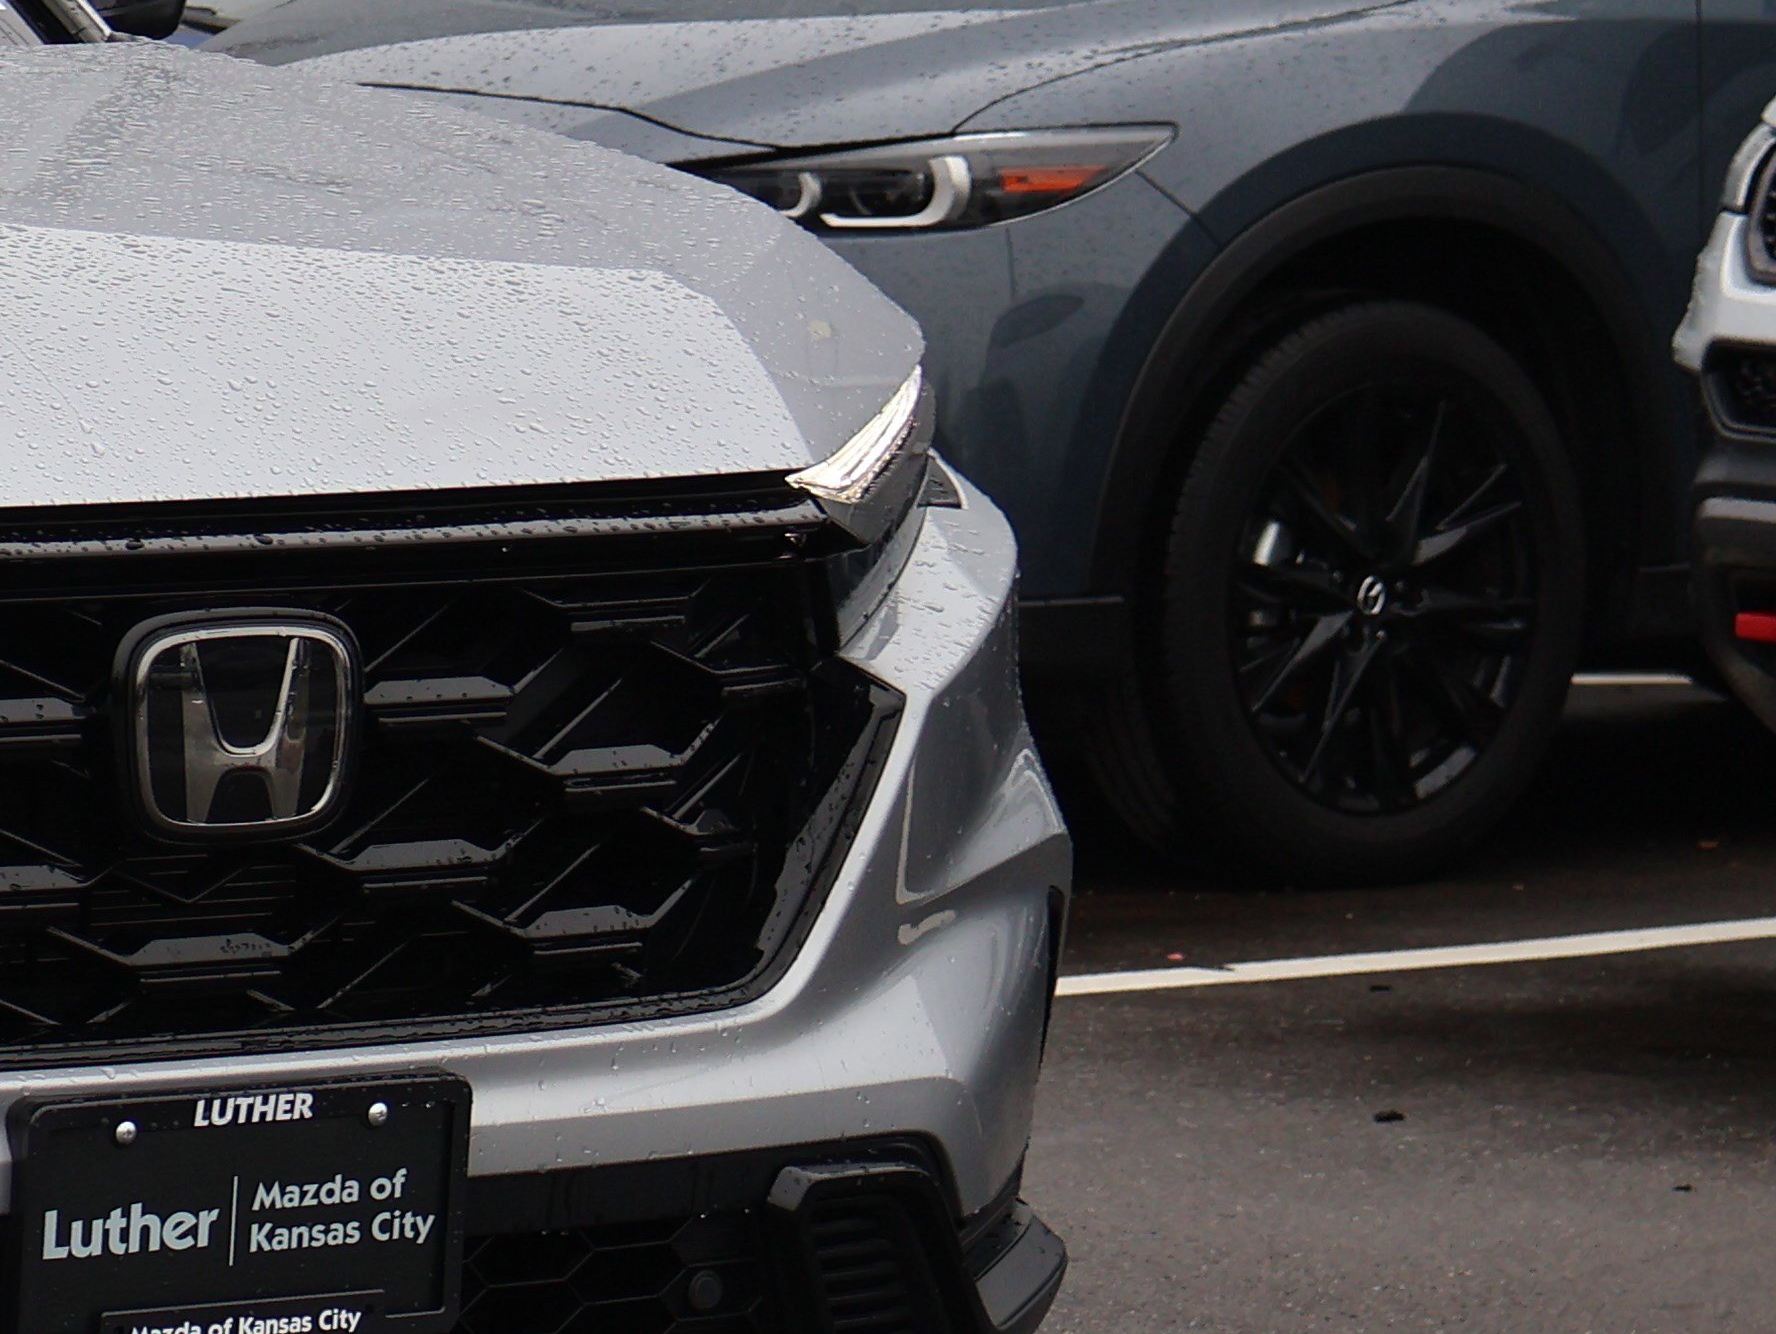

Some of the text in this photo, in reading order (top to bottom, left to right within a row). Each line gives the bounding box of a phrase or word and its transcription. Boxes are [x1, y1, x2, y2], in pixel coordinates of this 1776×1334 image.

[193, 1092, 314, 1127] LUTHER
[251, 1167, 409, 1211] Mazda of
[42, 1201, 221, 1260] Luther
[249, 1210, 436, 1253] Kansas City
[318, 1308, 362, 1333] City
